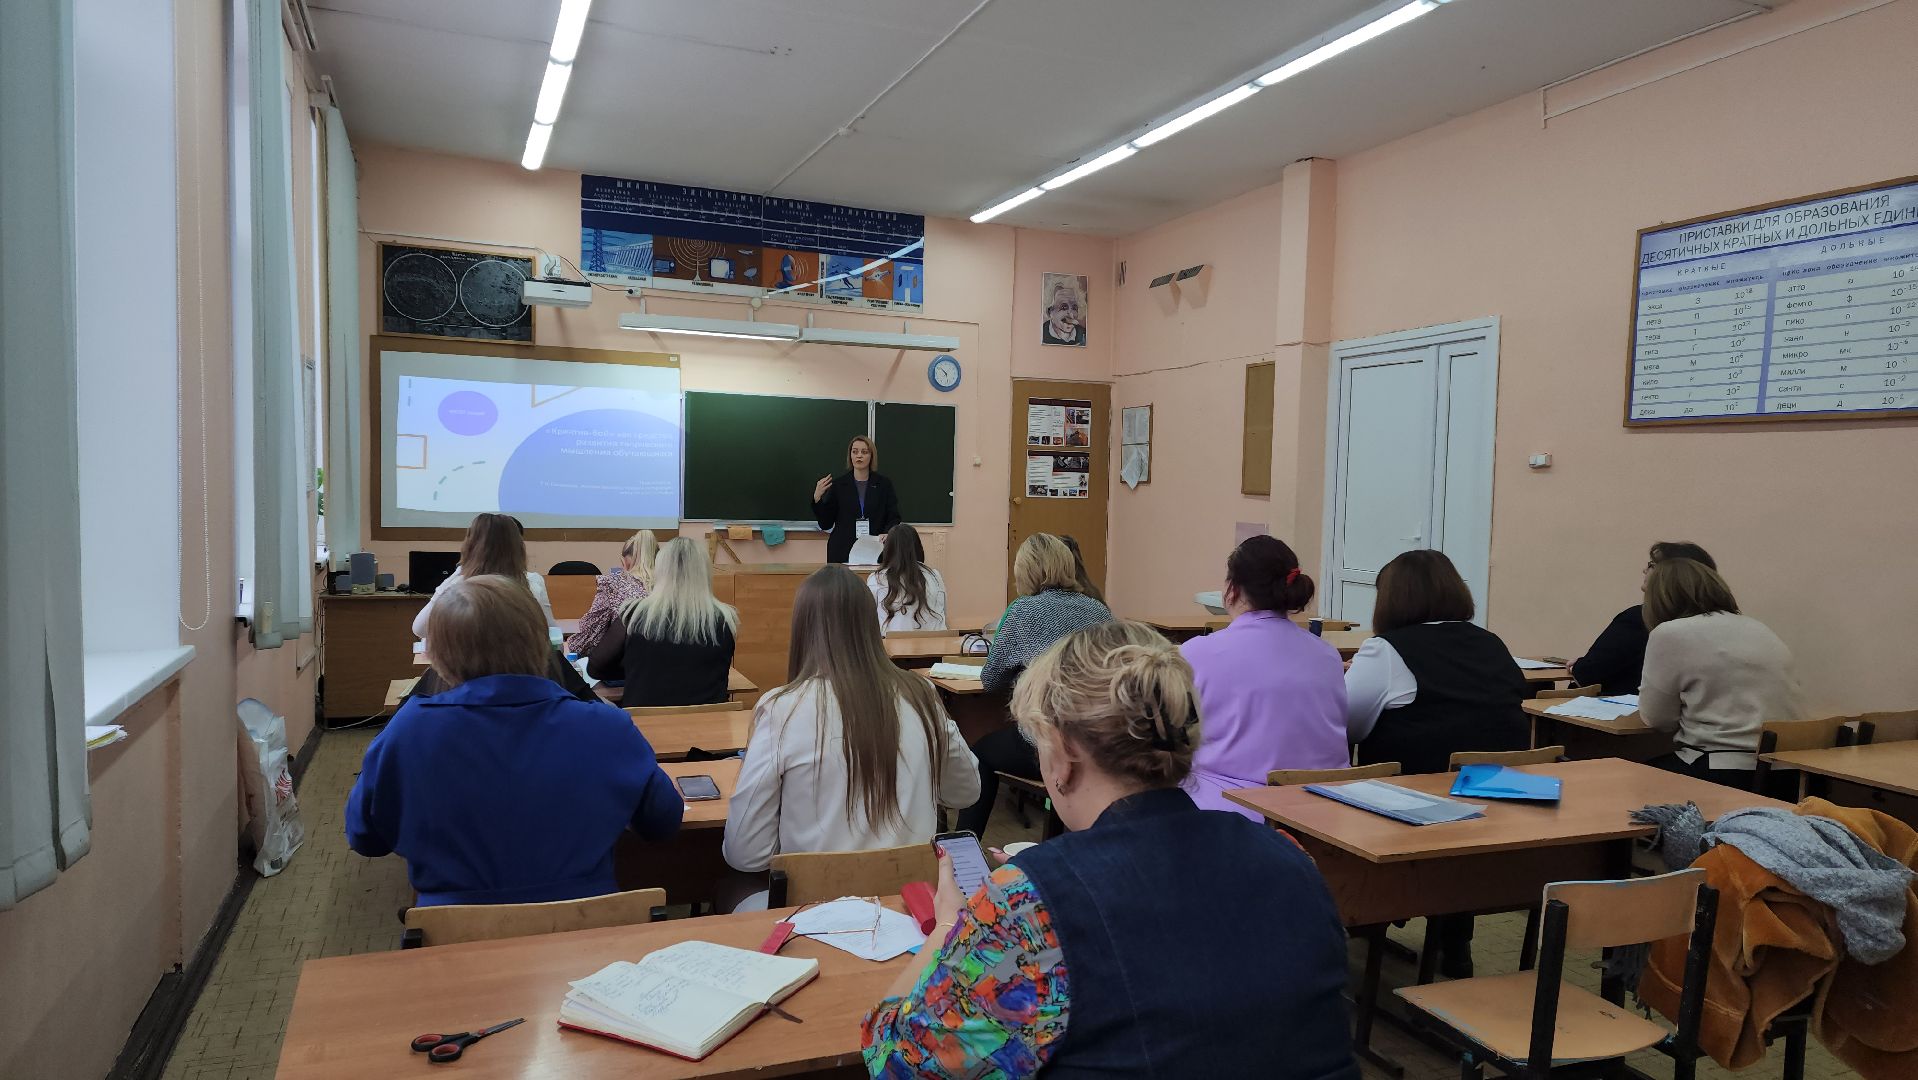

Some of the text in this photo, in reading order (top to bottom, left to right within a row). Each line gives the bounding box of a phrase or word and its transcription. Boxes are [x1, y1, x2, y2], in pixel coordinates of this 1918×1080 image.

[1640, 206, 1918, 265] ДЕСЯТИЧНЫХ КРАТНЫХ И ДОЛЬНЫХ ЕДИН
[1679, 194, 1890, 244] ПРИСТАВКИ ДЛЯ ОБРАЗОВАНИЯ
[1820, 236, 1885, 254] ДОЛЬНЫЕ
[1677, 262, 1727, 277] КРАТНЫЕ
